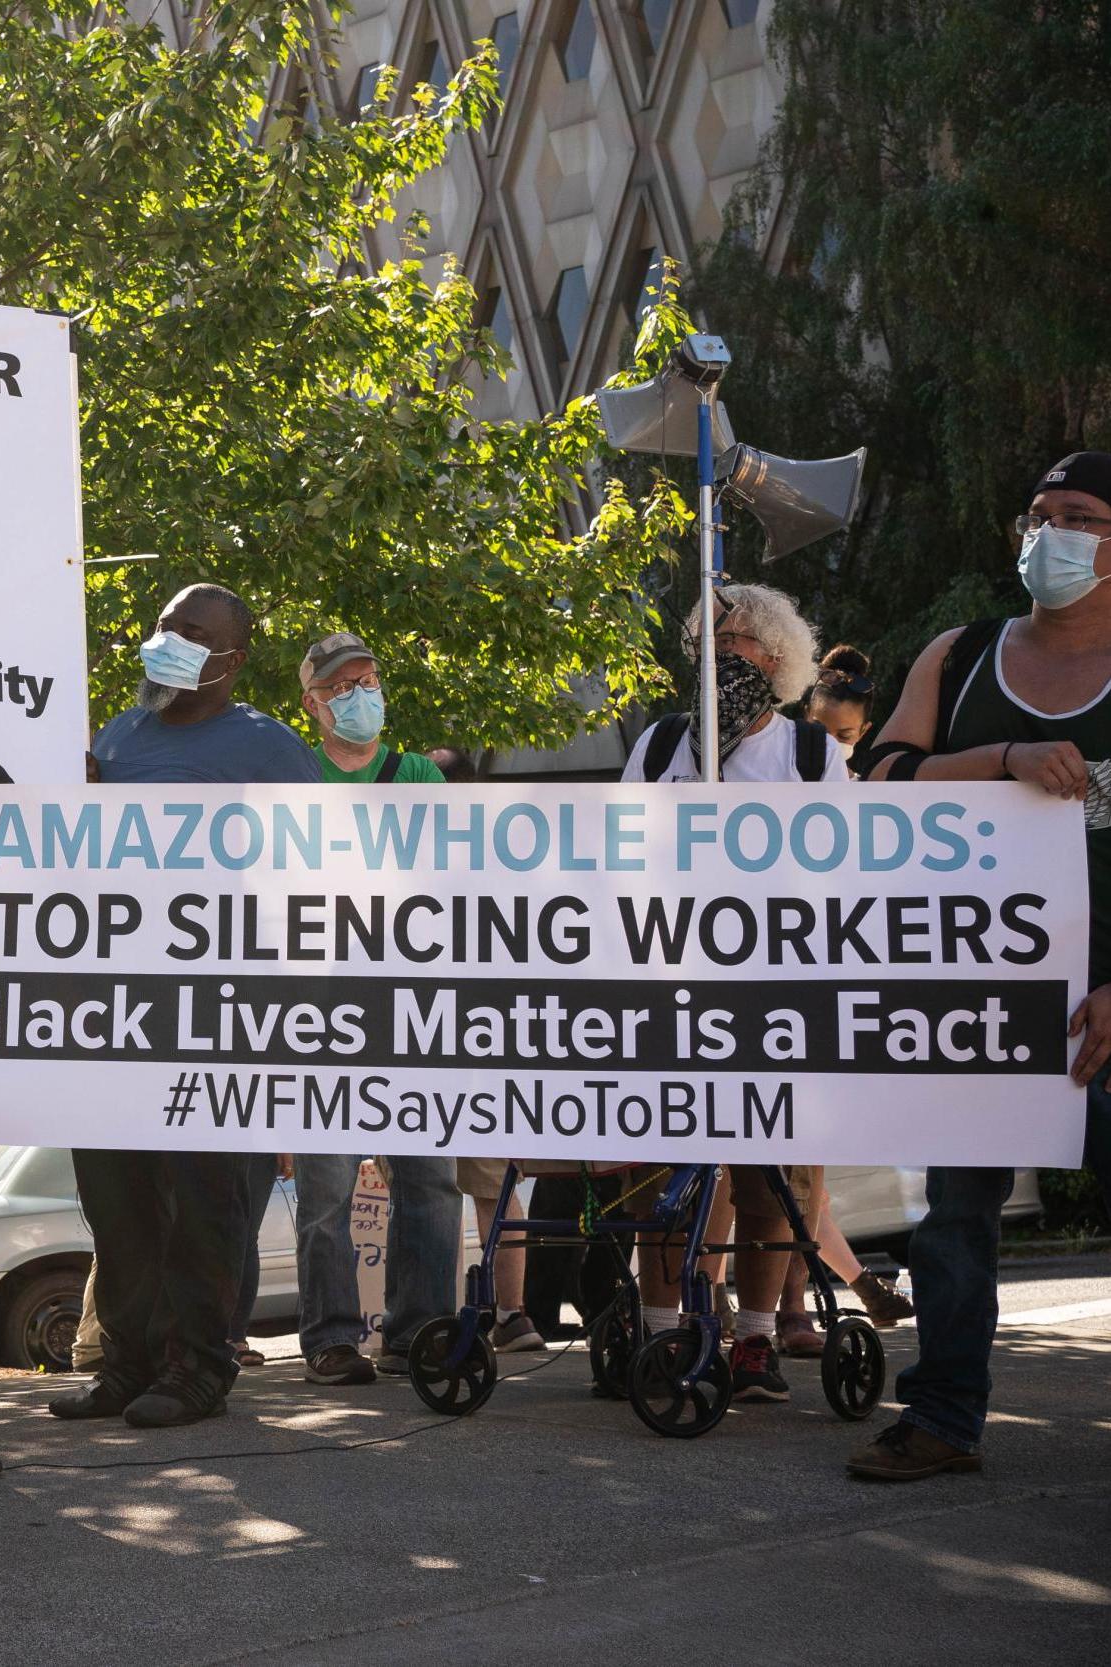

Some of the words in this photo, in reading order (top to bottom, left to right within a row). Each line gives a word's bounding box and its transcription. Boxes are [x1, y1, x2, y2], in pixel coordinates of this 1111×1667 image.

[676, 802, 997, 873] FOODS:
[166, 893, 591, 965] SILENCING
[617, 893, 1051, 966] WORKERS
[177, 983, 367, 1054] Lives
[393, 987, 649, 1060] Matter
[674, 989, 736, 1060] is
[763, 1008, 807, 1061] a
[837, 991, 1031, 1063] Fact.
[163, 1071, 794, 1148] #WFMSaysNoToBLM
